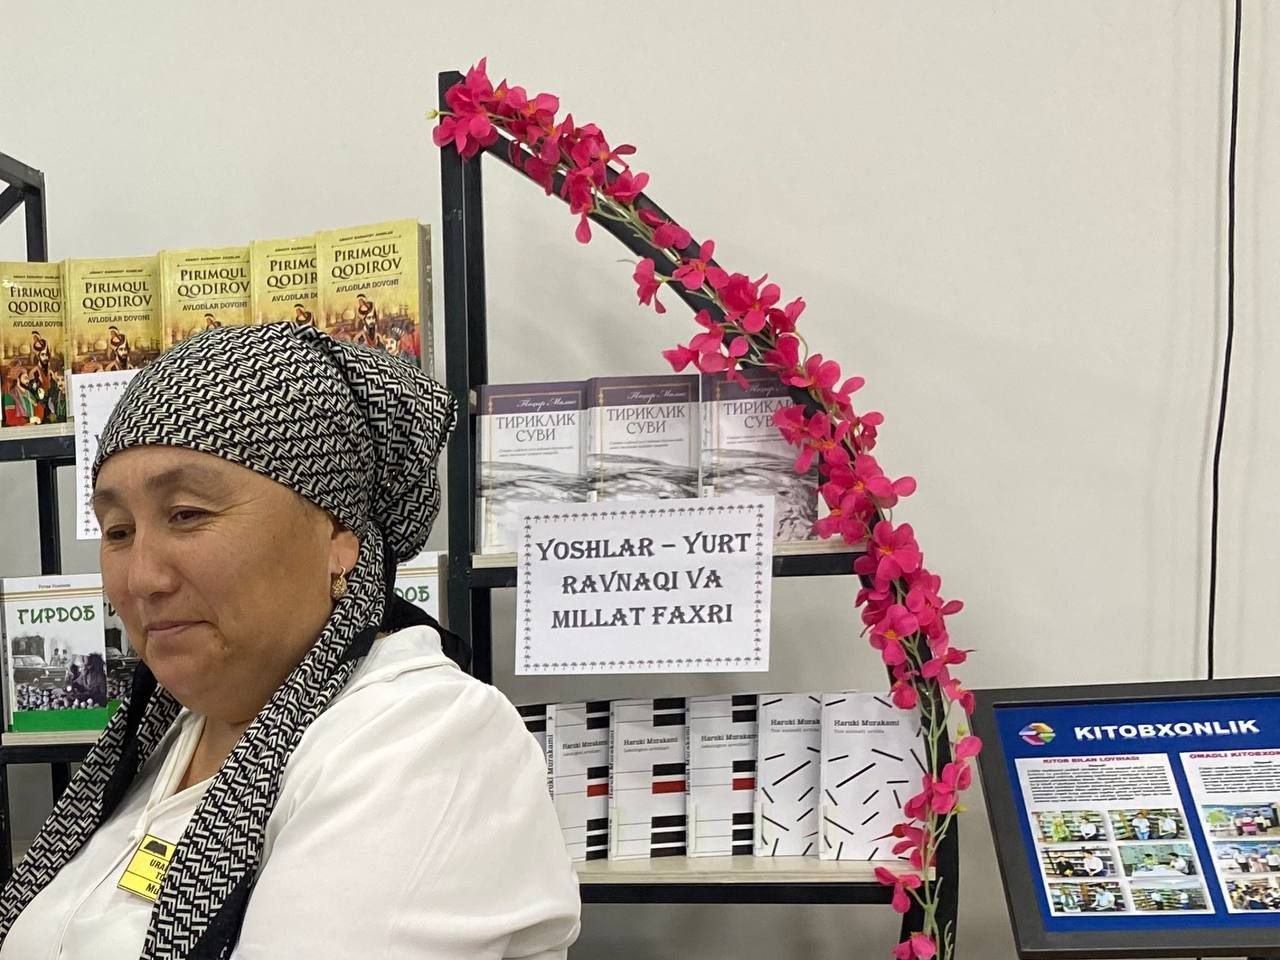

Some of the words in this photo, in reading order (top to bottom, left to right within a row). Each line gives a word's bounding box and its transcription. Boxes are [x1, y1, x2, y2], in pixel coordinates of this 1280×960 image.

[334, 243, 399, 262] PIRIMQUL
[180, 267, 247, 281] PIRIMQUL
[331, 257, 402, 279] QODIROV
[85, 281, 149, 294] PIRIMQUL
[177, 281, 250, 297] QODIROV
[336, 282, 371, 294] AVLODLAR
[371, 278, 400, 289] DOVONI
[8, 301, 62, 315] QODIRO
[82, 294, 153, 310] QODIROV
[182, 303, 219, 311] AVLODLAR
[87, 315, 123, 324] AVLODLAR
[124, 314, 150, 322] DOVONI
[496, 413, 576, 430] ТИРИКЛИК
[606, 405, 685, 422] ТИРИКЛИК
[515, 428, 556, 443] СУВИ
[626, 420, 666, 435] СУВИ
[536, 537, 655, 561] YOSHLAR
[683, 531, 752, 555] YURT
[561, 570, 678, 595] RAVNAQI
[686, 567, 723, 590] VA
[17, 605, 95, 625] ГИРДОБ
[551, 607, 646, 629] MILLAT
[652, 604, 733, 625] FAXRI
[770, 718, 797, 726] Haruki
[797, 718, 820, 726] Murak
[834, 719, 860, 727] Haruki
[861, 719, 900, 727] Murakami
[1073, 719, 1260, 741] KITOBXONLIK
[623, 738, 645, 746] Haruki
[647, 737, 679, 745] Murakami
[701, 734, 725, 742] Haruki
